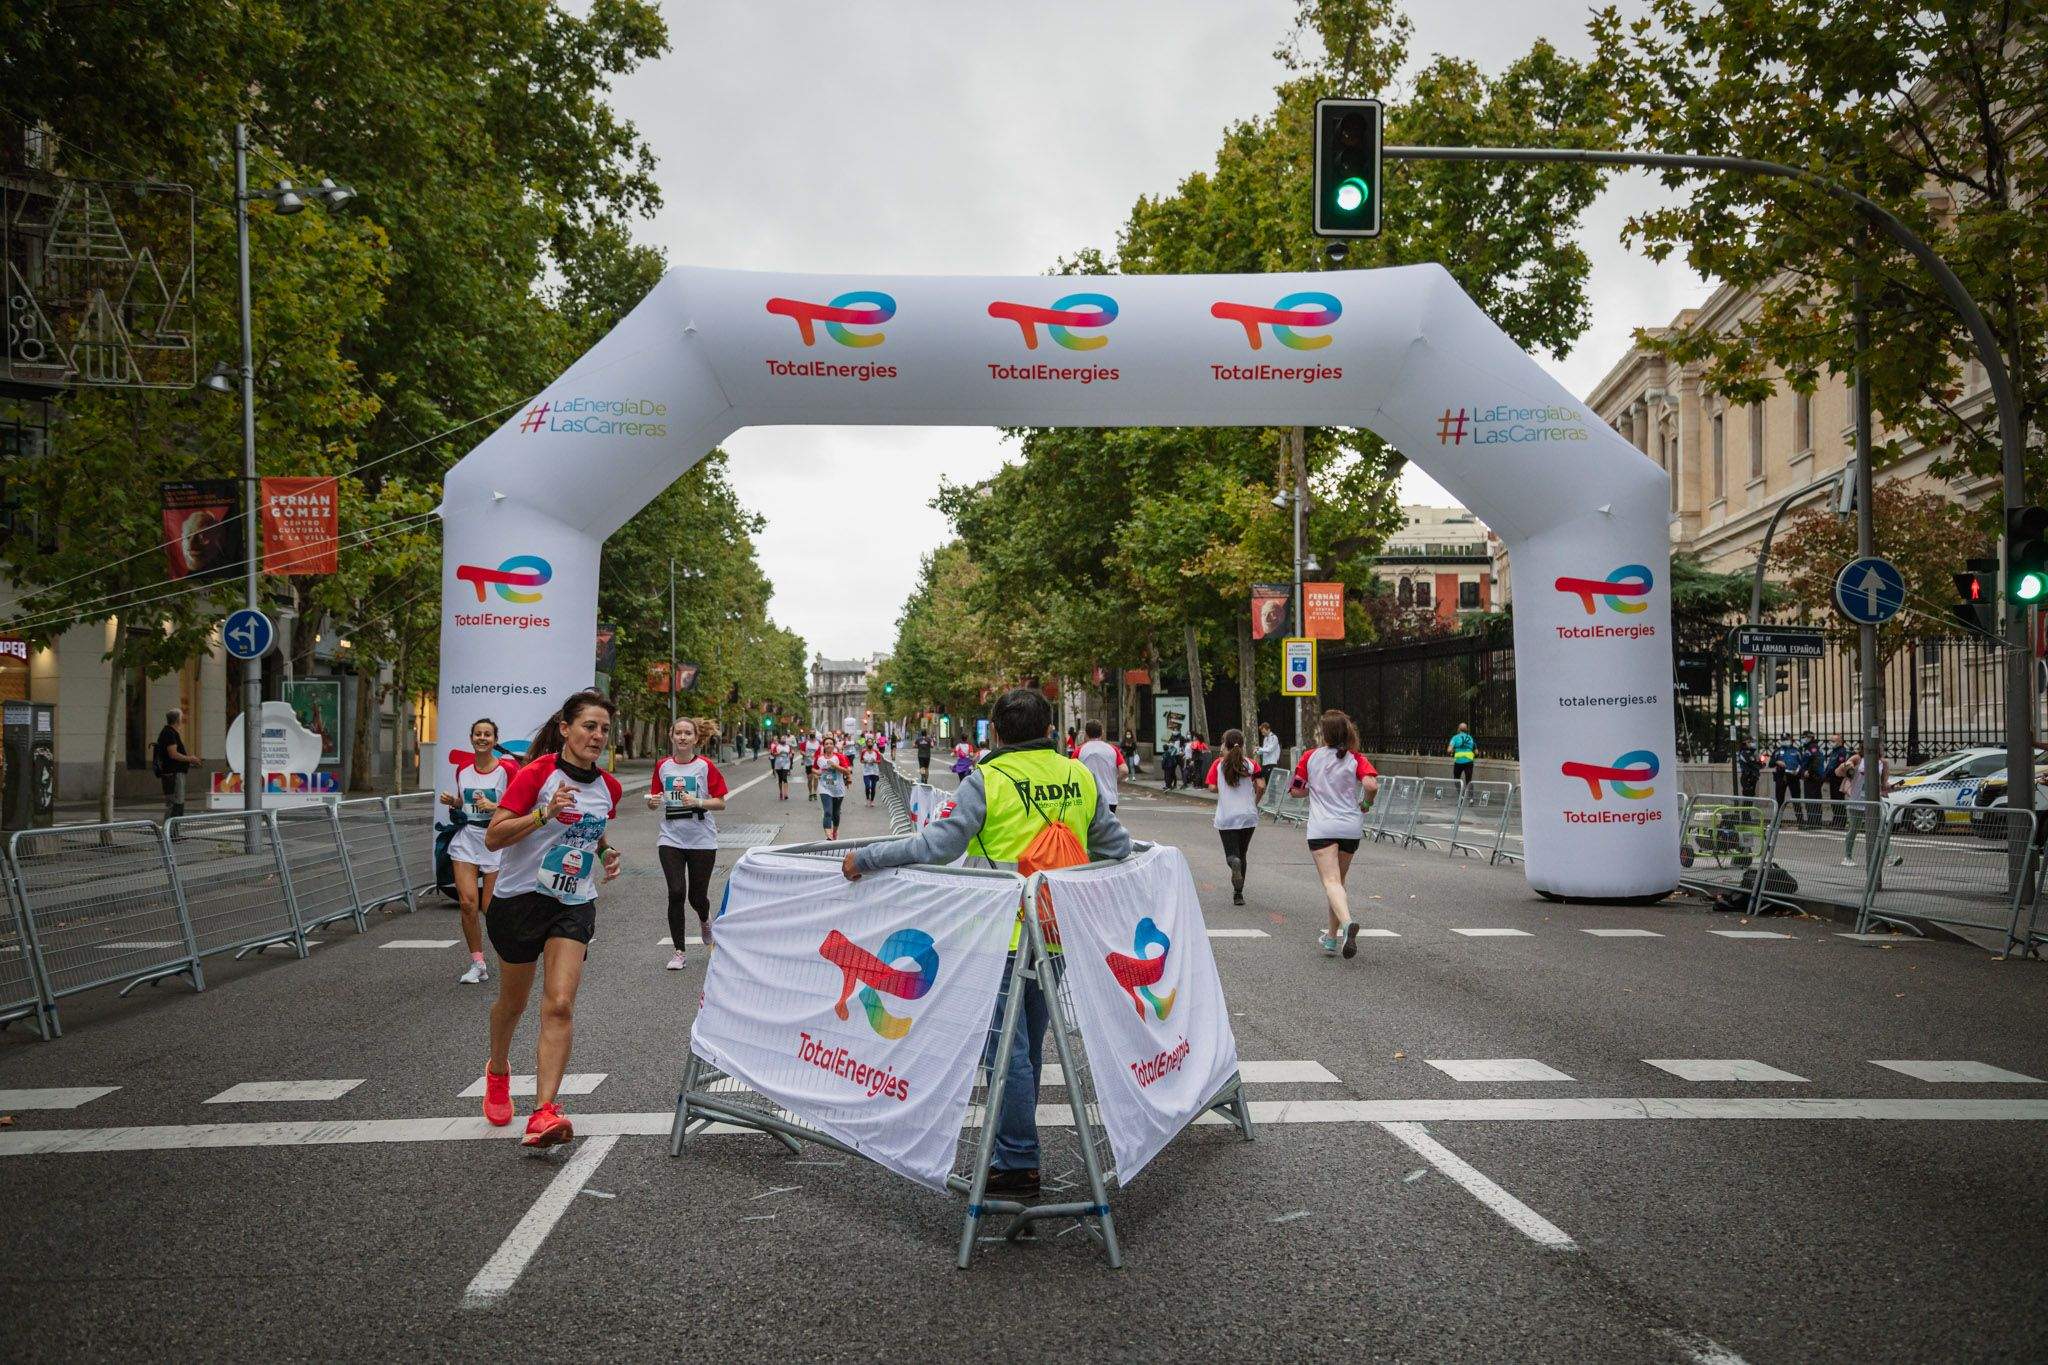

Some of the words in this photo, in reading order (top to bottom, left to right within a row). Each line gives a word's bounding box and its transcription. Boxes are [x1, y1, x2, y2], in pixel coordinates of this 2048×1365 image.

[766, 360, 897, 381] TotalEnergies
[988, 363, 1120, 384] TotalEnergies
[1211, 363, 1342, 384] TotalEnergies
[551, 417, 666, 436] LasCarreras
[1474, 426, 1588, 444] LasCarreras
[271, 493, 330, 505] FERNÁN
[272, 506, 331, 517] GÓMEZ
[455, 613, 550, 629] TotalEnergies
[1556, 624, 1656, 639] TotalEnergies
[1752, 644, 1760, 652] LA
[1762, 644, 1787, 653] ARMADA
[1790, 645, 1821, 655] ESPAÑOLA
[452, 683, 547, 695] totalenergies.es
[1559, 694, 1657, 707] totalenergies.es
[1034, 782, 1082, 801] ADM
[1563, 810, 1662, 825] TotalEnergies
[798, 1032, 909, 1101] TotalEnergies
